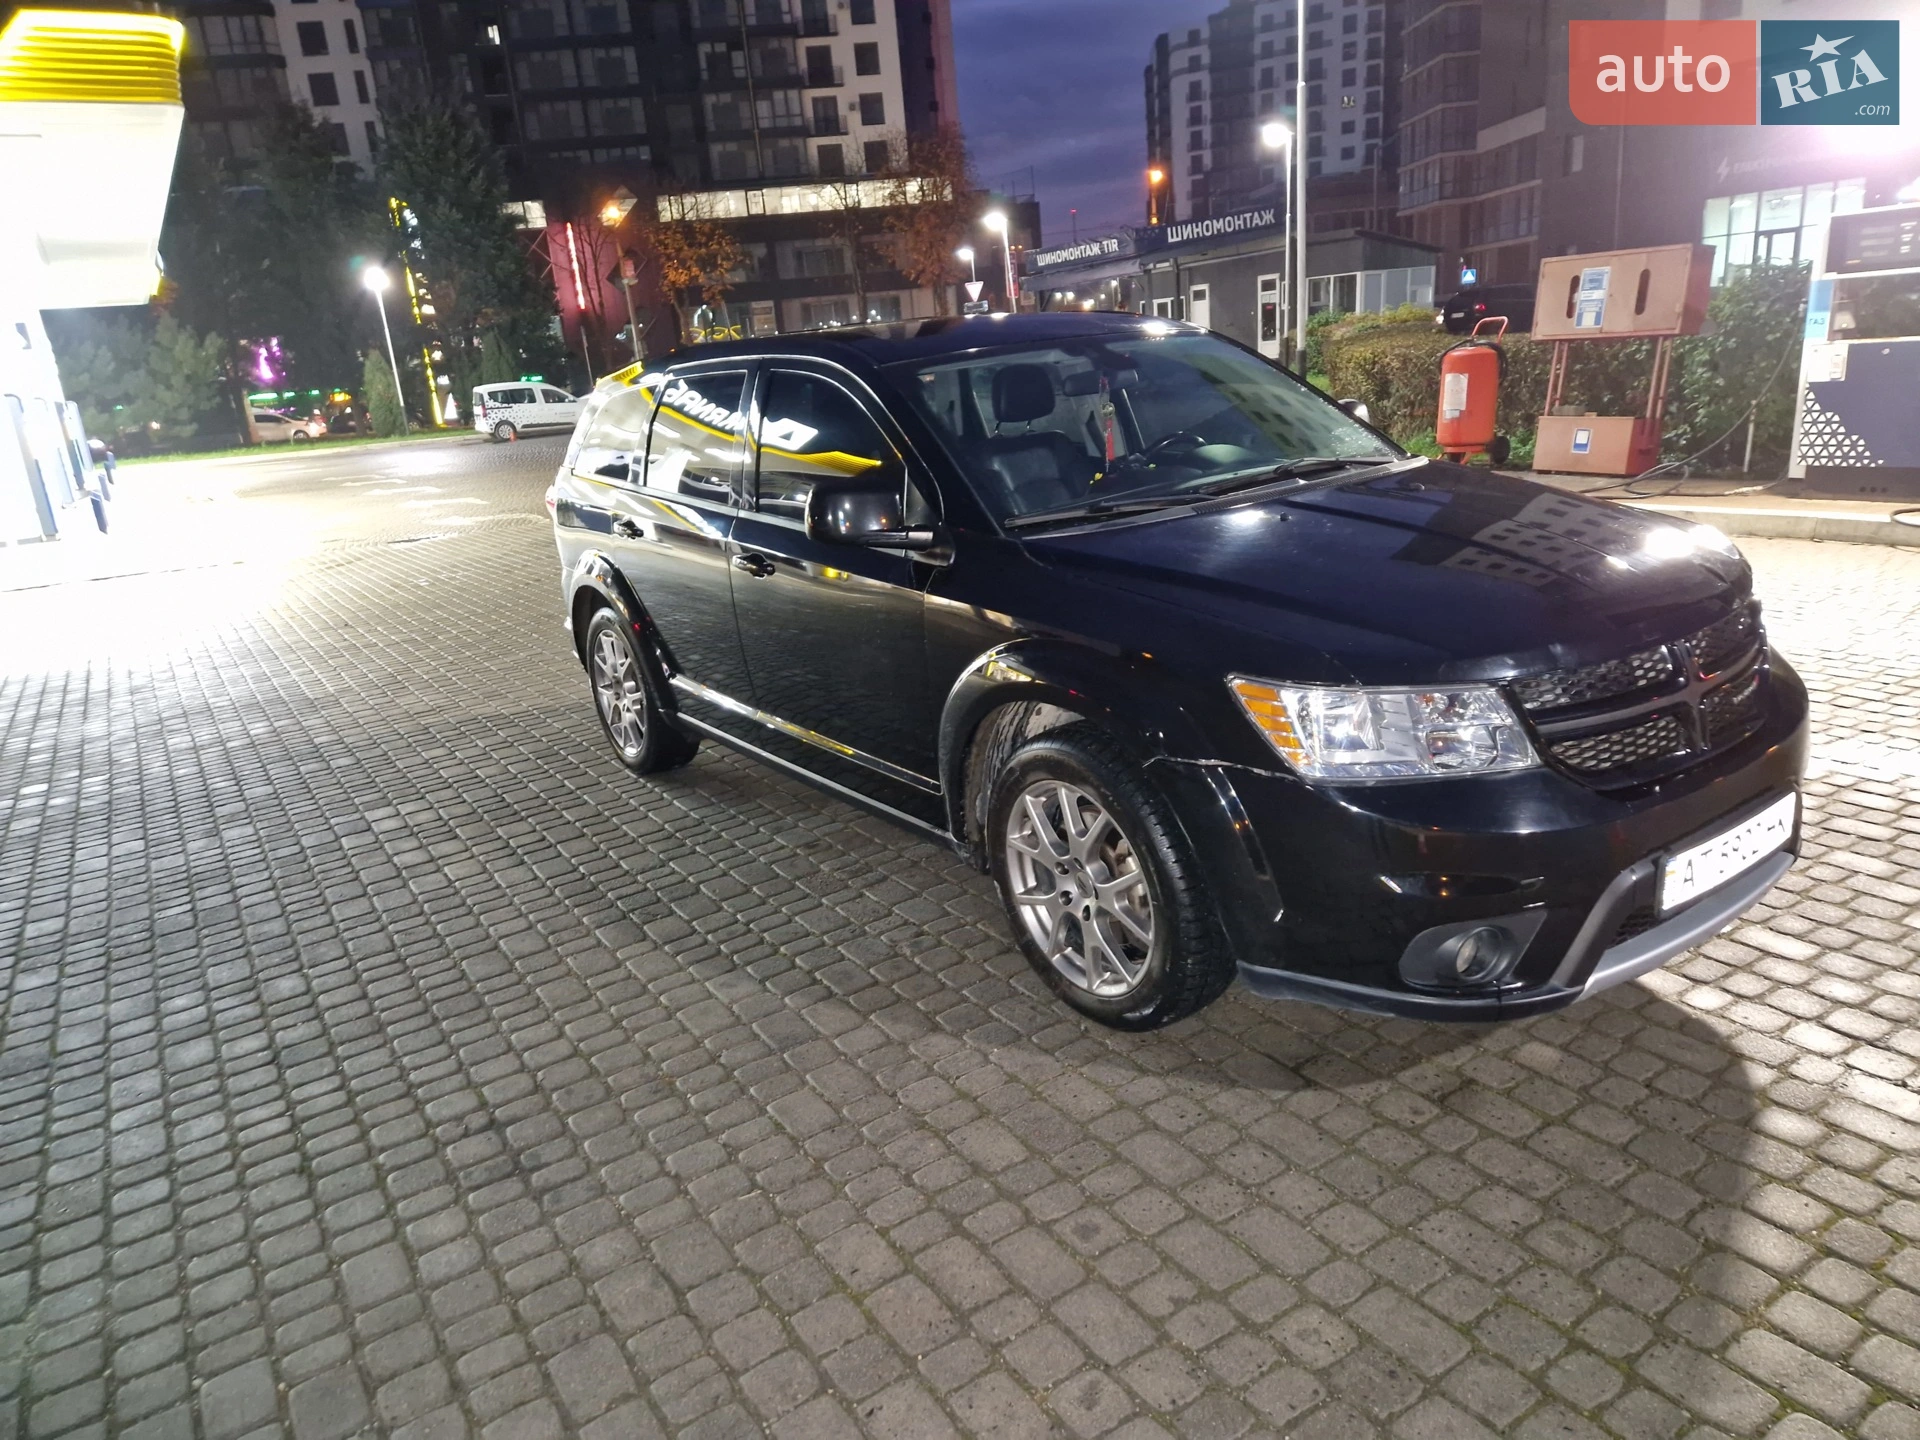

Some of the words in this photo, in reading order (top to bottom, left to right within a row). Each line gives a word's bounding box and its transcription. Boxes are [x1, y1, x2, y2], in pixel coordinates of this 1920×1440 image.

[1167, 208, 1276, 243] ШИНОМОНТАЖ
[1036, 242, 1101, 267] ШИНОМОНТАЖ
[1102, 238, 1119, 253] TIR
